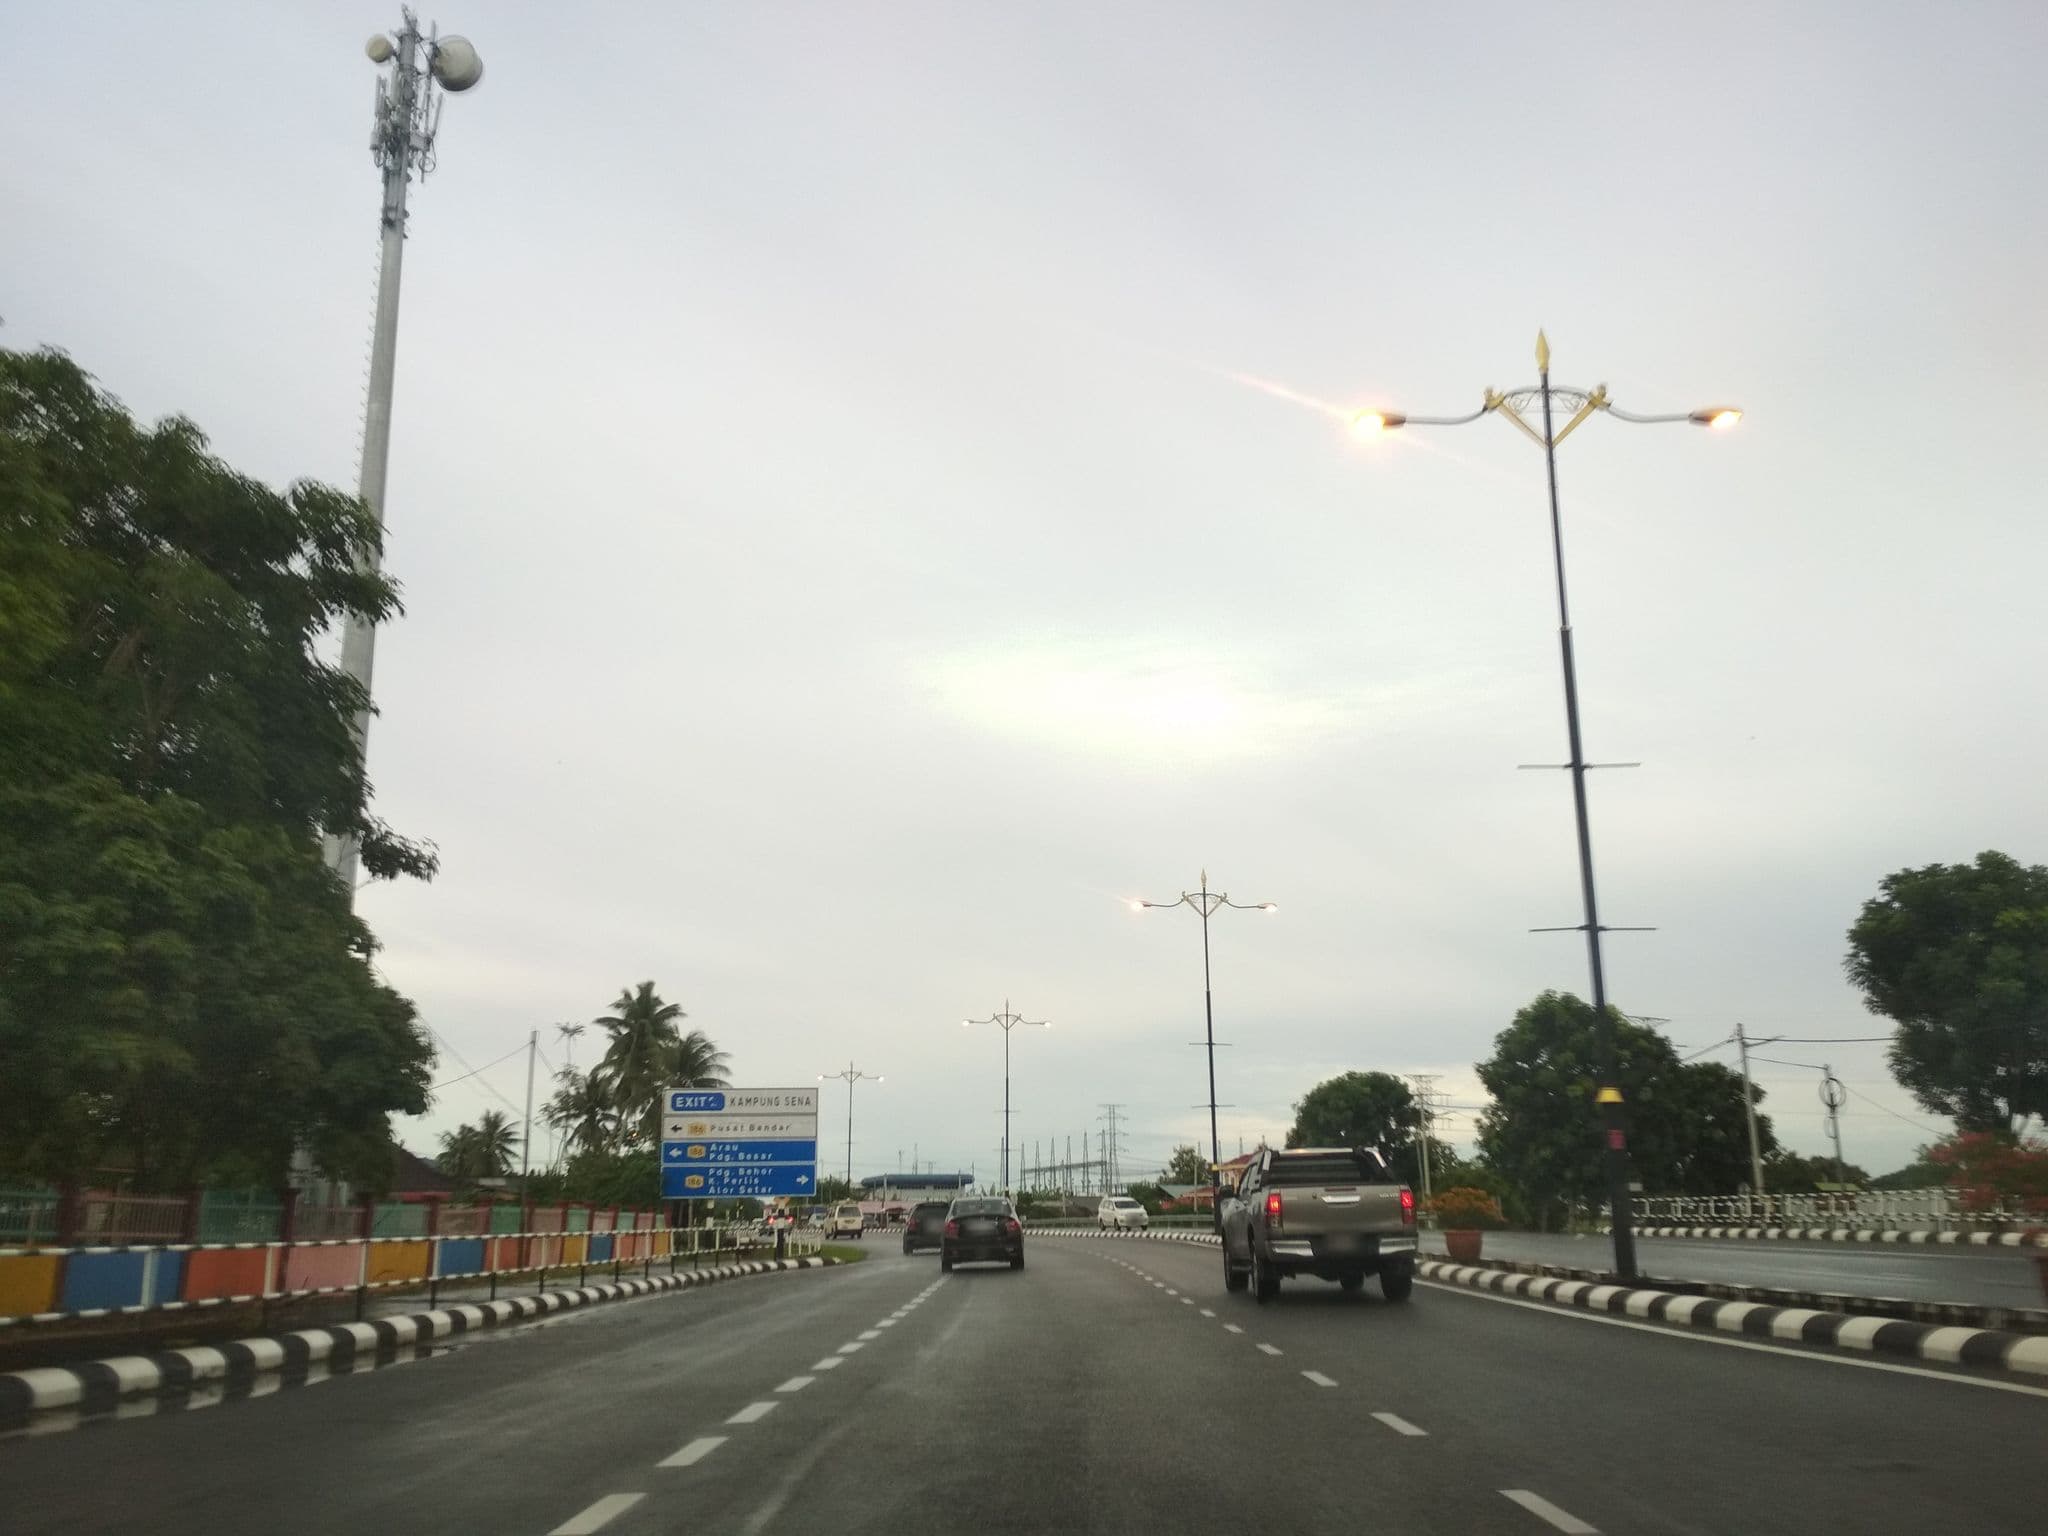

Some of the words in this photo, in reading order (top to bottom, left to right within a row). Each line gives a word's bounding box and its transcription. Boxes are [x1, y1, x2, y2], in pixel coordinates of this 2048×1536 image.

[676, 1097, 704, 1107] EXIT
[729, 1096, 779, 1107] KAMPUNG
[785, 1096, 811, 1106] SENA
[710, 1124, 744, 1132] Pusat
[749, 1123, 791, 1132] Bandar
[710, 1143, 739, 1152] Arau
[709, 1153, 734, 1162] Pdg.
[738, 1152, 773, 1161] Besar
[708, 1168, 734, 1177] Pdg.
[738, 1167, 773, 1176] Behor
[723, 1177, 759, 1185] Perlis
[708, 1186, 734, 1194] Alor
[738, 1186, 773, 1194] Setar
